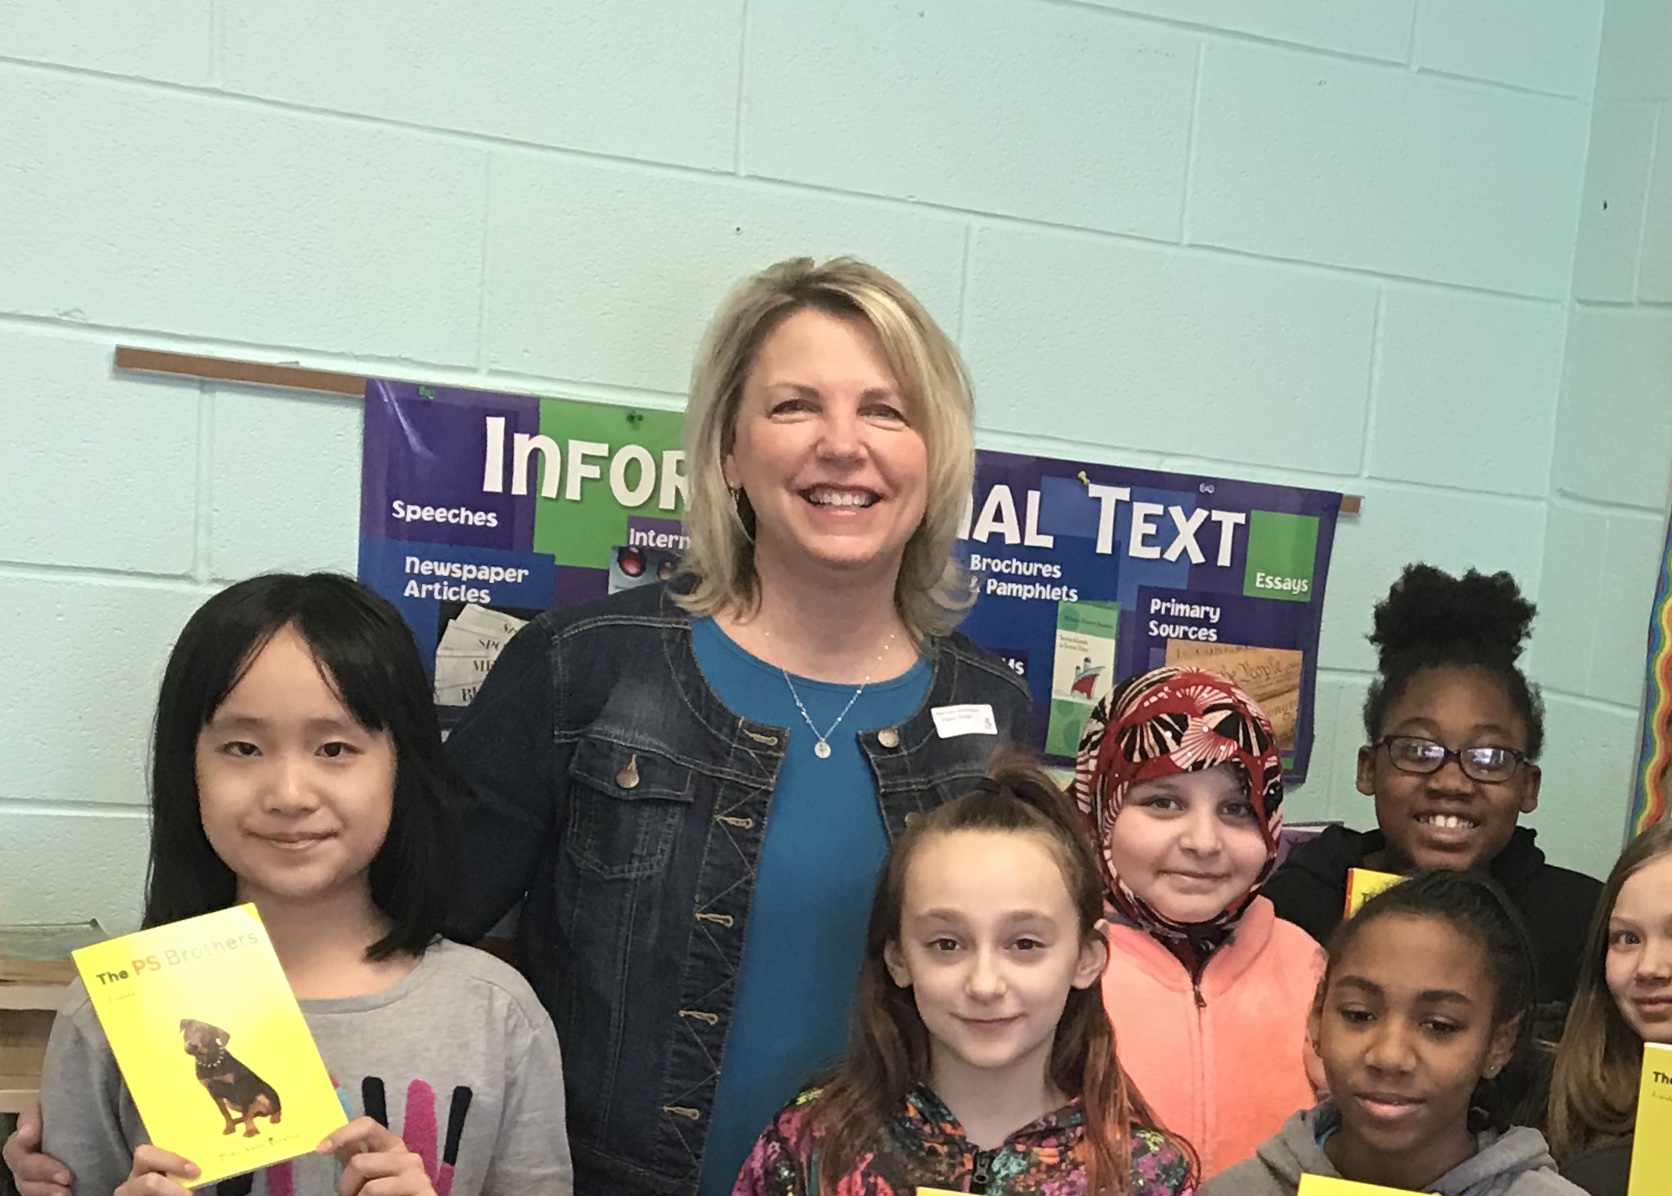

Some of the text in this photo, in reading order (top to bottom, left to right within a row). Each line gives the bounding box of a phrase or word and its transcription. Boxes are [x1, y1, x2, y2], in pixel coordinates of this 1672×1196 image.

[391, 499, 498, 527] Speeches
[405, 556, 529, 583] Newspaper
[969, 553, 1062, 579] Brochures
[403, 579, 491, 604] Articles
[986, 578, 1081, 607] Pamphlets
[1255, 572, 1308, 595] Essays
[1150, 598, 1220, 623] Primary
[1148, 619, 1217, 642] Sources
[96, 933, 258, 986] The PS Brothers
